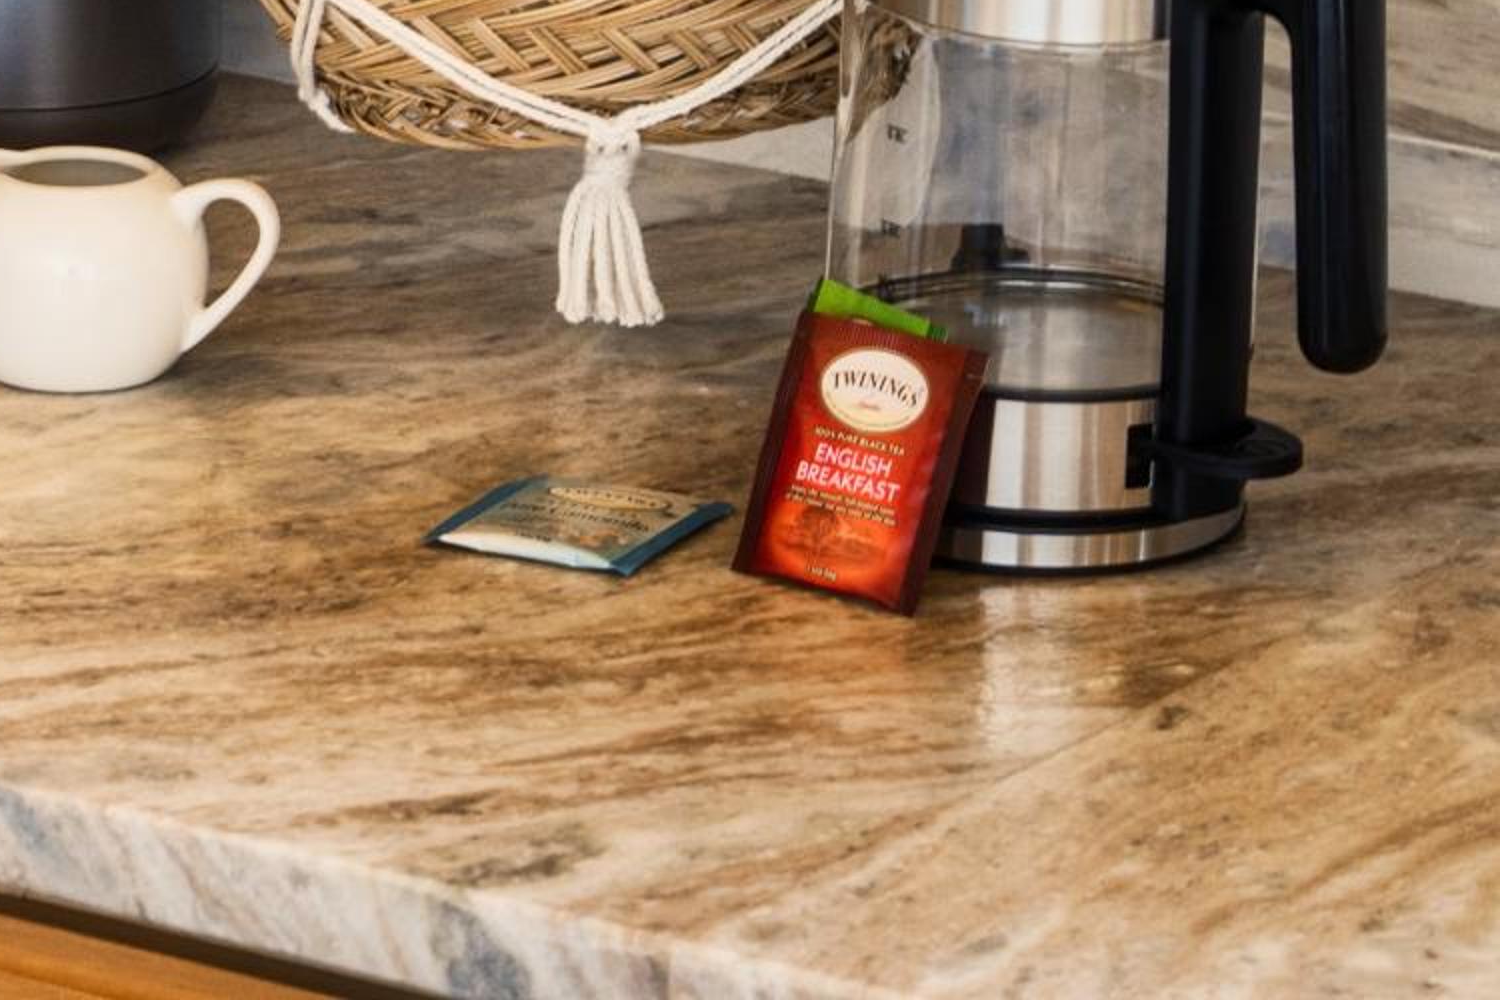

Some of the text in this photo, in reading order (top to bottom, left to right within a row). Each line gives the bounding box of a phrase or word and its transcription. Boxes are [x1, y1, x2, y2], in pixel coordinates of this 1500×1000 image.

[831, 369, 919, 408] TWININGS
[815, 442, 893, 479] ENGLISH
[795, 460, 901, 503] BREAKFAST
